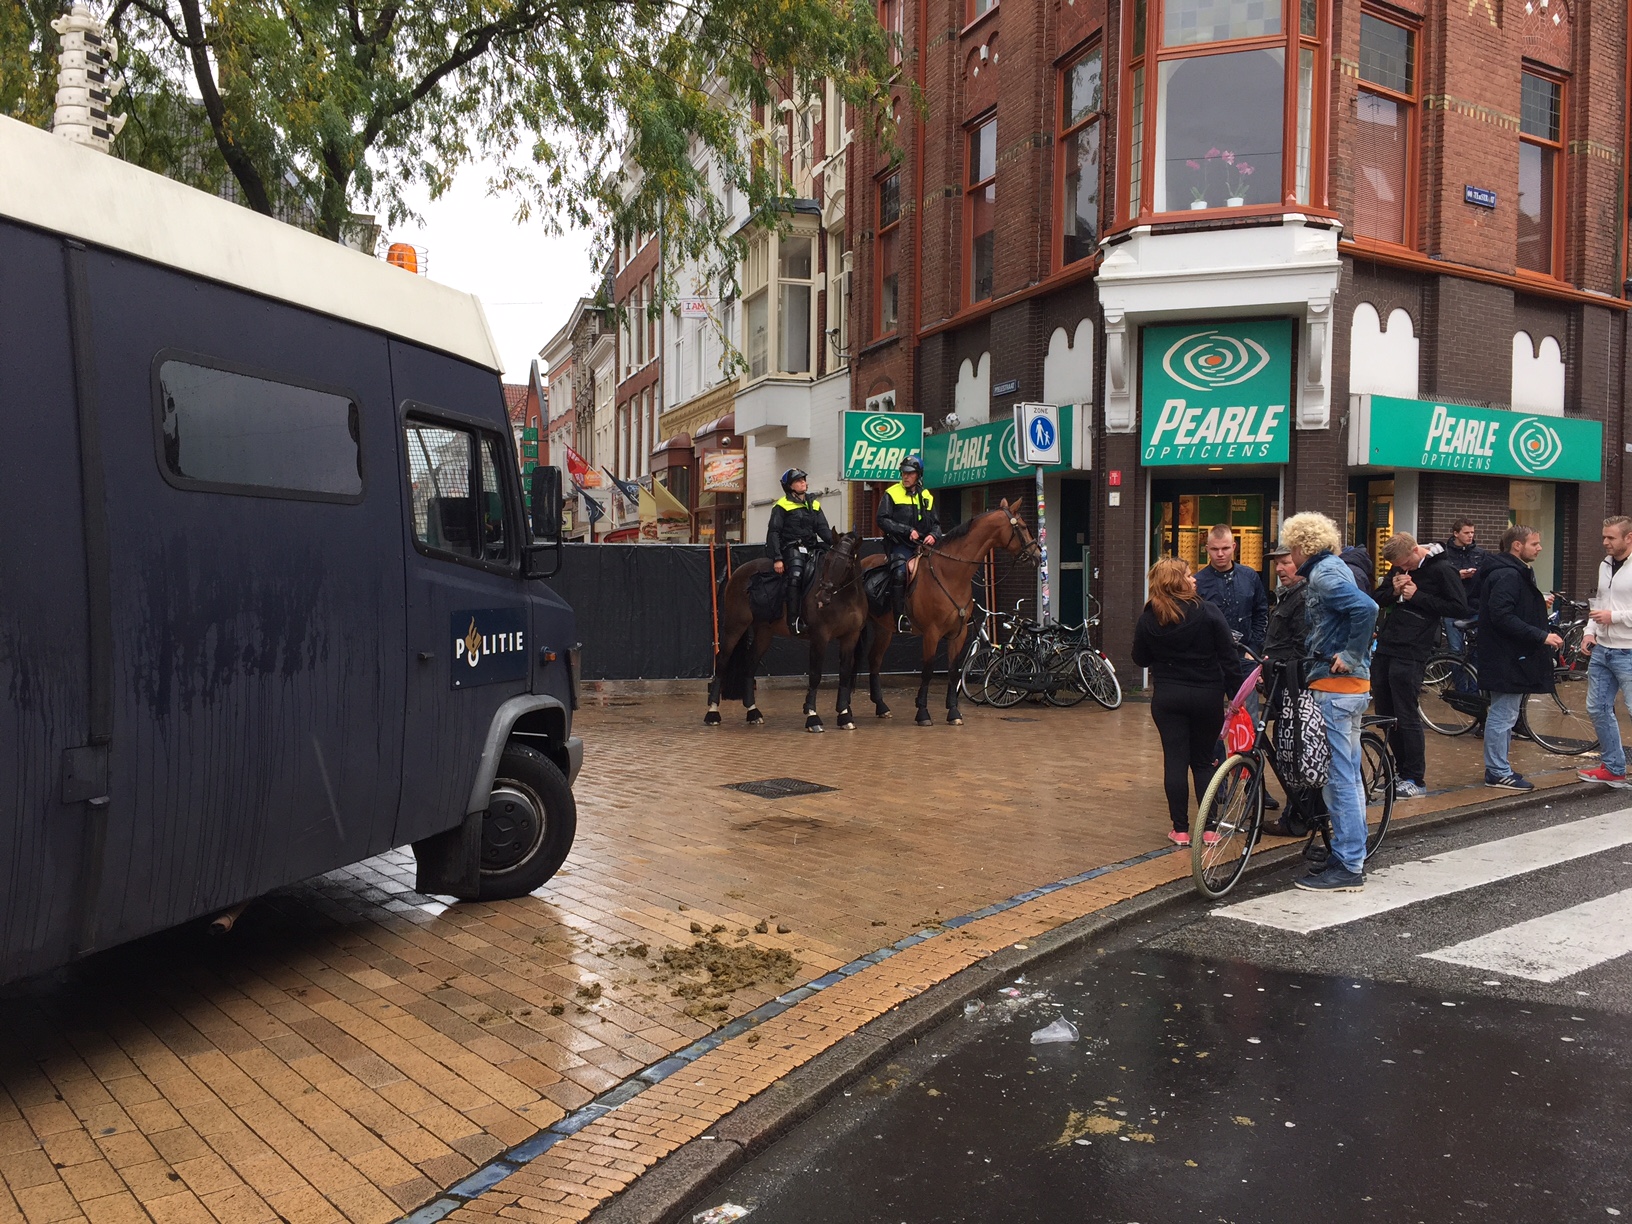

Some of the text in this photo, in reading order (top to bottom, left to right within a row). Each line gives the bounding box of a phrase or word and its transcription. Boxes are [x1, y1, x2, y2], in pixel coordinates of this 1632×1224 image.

[1033, 407, 1049, 415] ZONE
[1150, 398, 1286, 445] PEARLE
[1425, 405, 1500, 456] PEARLE
[945, 433, 992, 472] PEARLE
[1144, 443, 1270, 460] OPTICIENS
[1421, 452, 1491, 471] OPTICIENS
[942, 467, 987, 484] OPTICIENS
[455, 631, 524, 668] POLITIE
